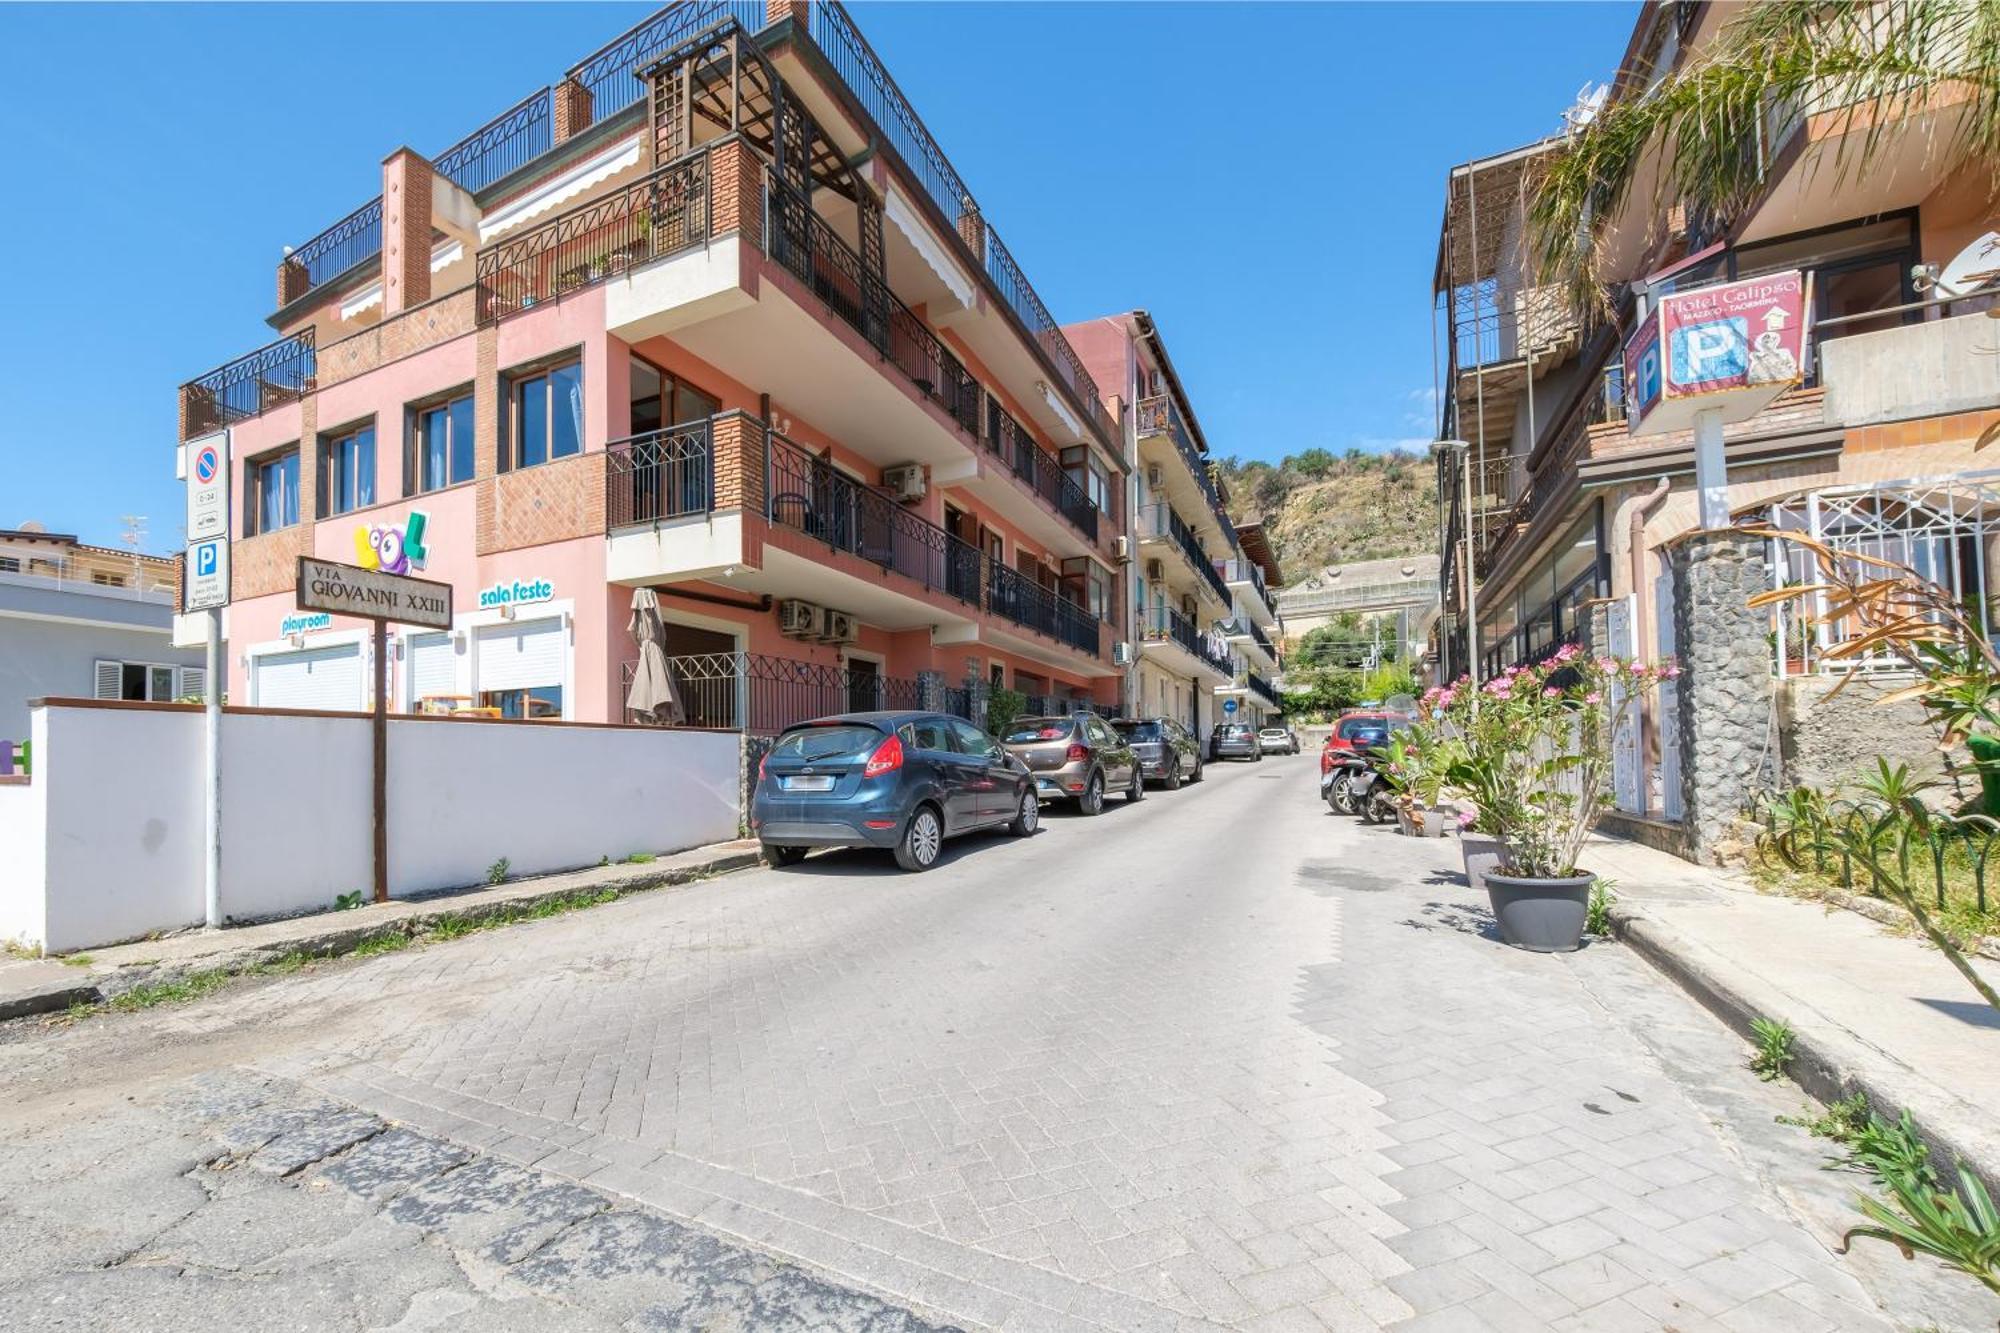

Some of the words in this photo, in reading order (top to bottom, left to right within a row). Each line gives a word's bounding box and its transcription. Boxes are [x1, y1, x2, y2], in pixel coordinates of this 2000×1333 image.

[1669, 294, 1716, 315] Hotel
[1722, 281, 1796, 304] Calipso
[1688, 326, 1732, 378] P
[201, 547, 214, 573] P
[315, 567, 341, 580] VIA
[311, 580, 398, 607] GIOVANNI
[407, 594, 445, 614] XXIII
[481, 585, 511, 606] sala
[513, 580, 551, 600] feste
[282, 613, 330, 637] playroom
